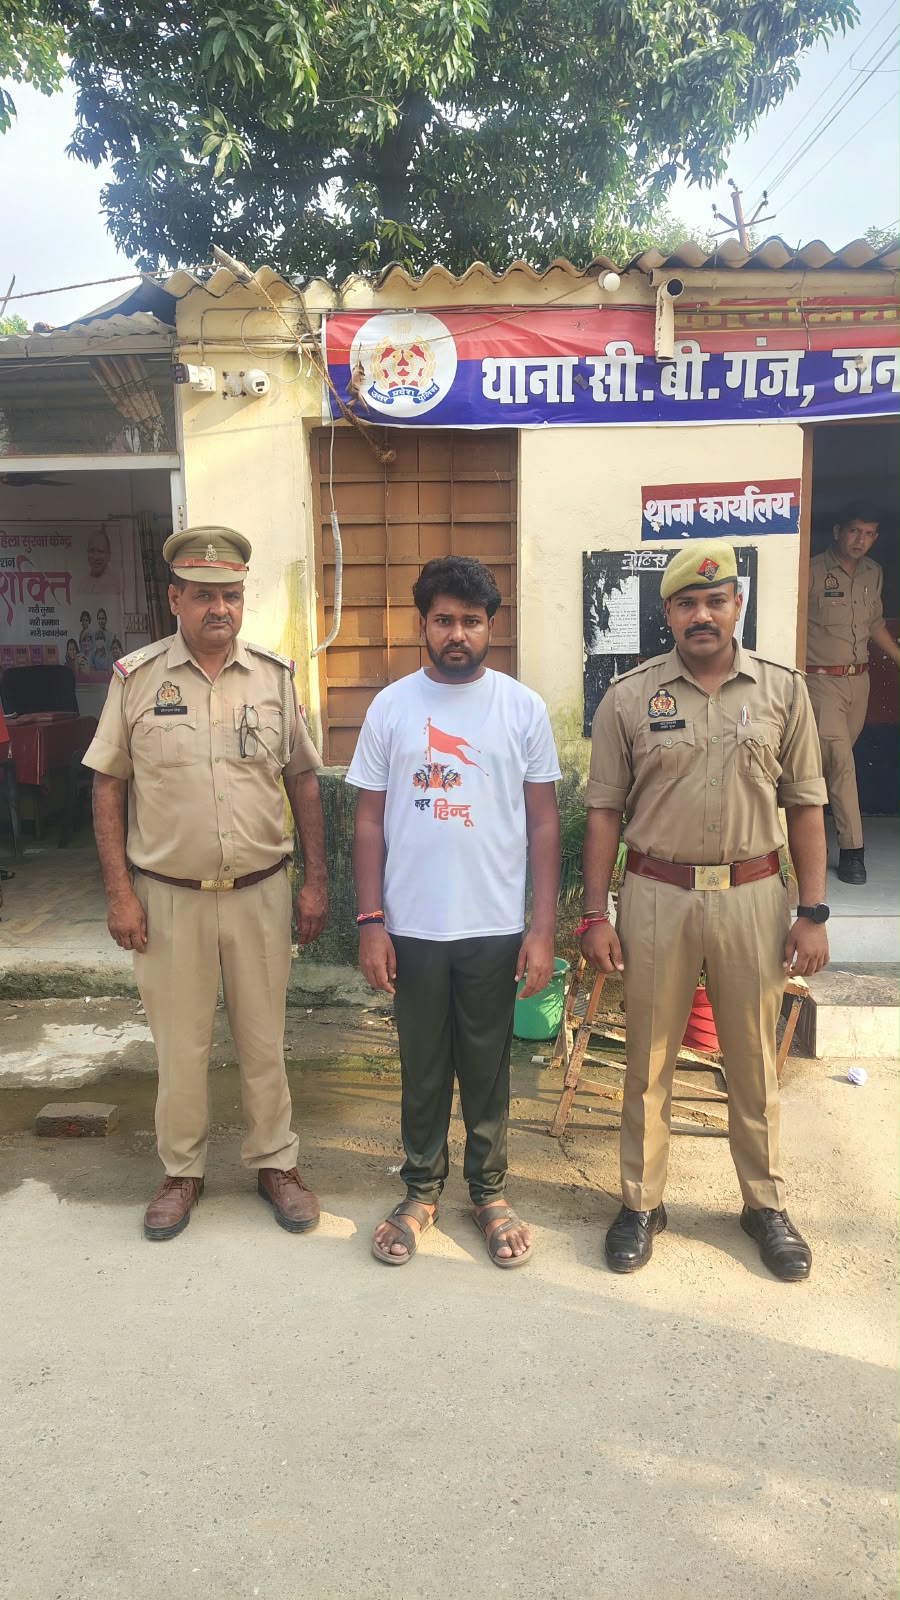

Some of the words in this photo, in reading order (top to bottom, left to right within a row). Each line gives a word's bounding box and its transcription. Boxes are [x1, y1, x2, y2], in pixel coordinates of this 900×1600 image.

[481, 356, 579, 404] थाना
[391, 387, 415, 397] प्रदेश
[643, 498, 697, 528] थाना
[698, 485, 795, 525] कार्यालय
[0, 530, 20, 548] हिला
[21, 535, 48, 553] सुरक्षा
[0, 557, 16, 568] शन
[621, 550, 668, 569] नोटिस
[414, 798, 431, 810] कट्टर
[433, 798, 474, 827] हिन्दू
